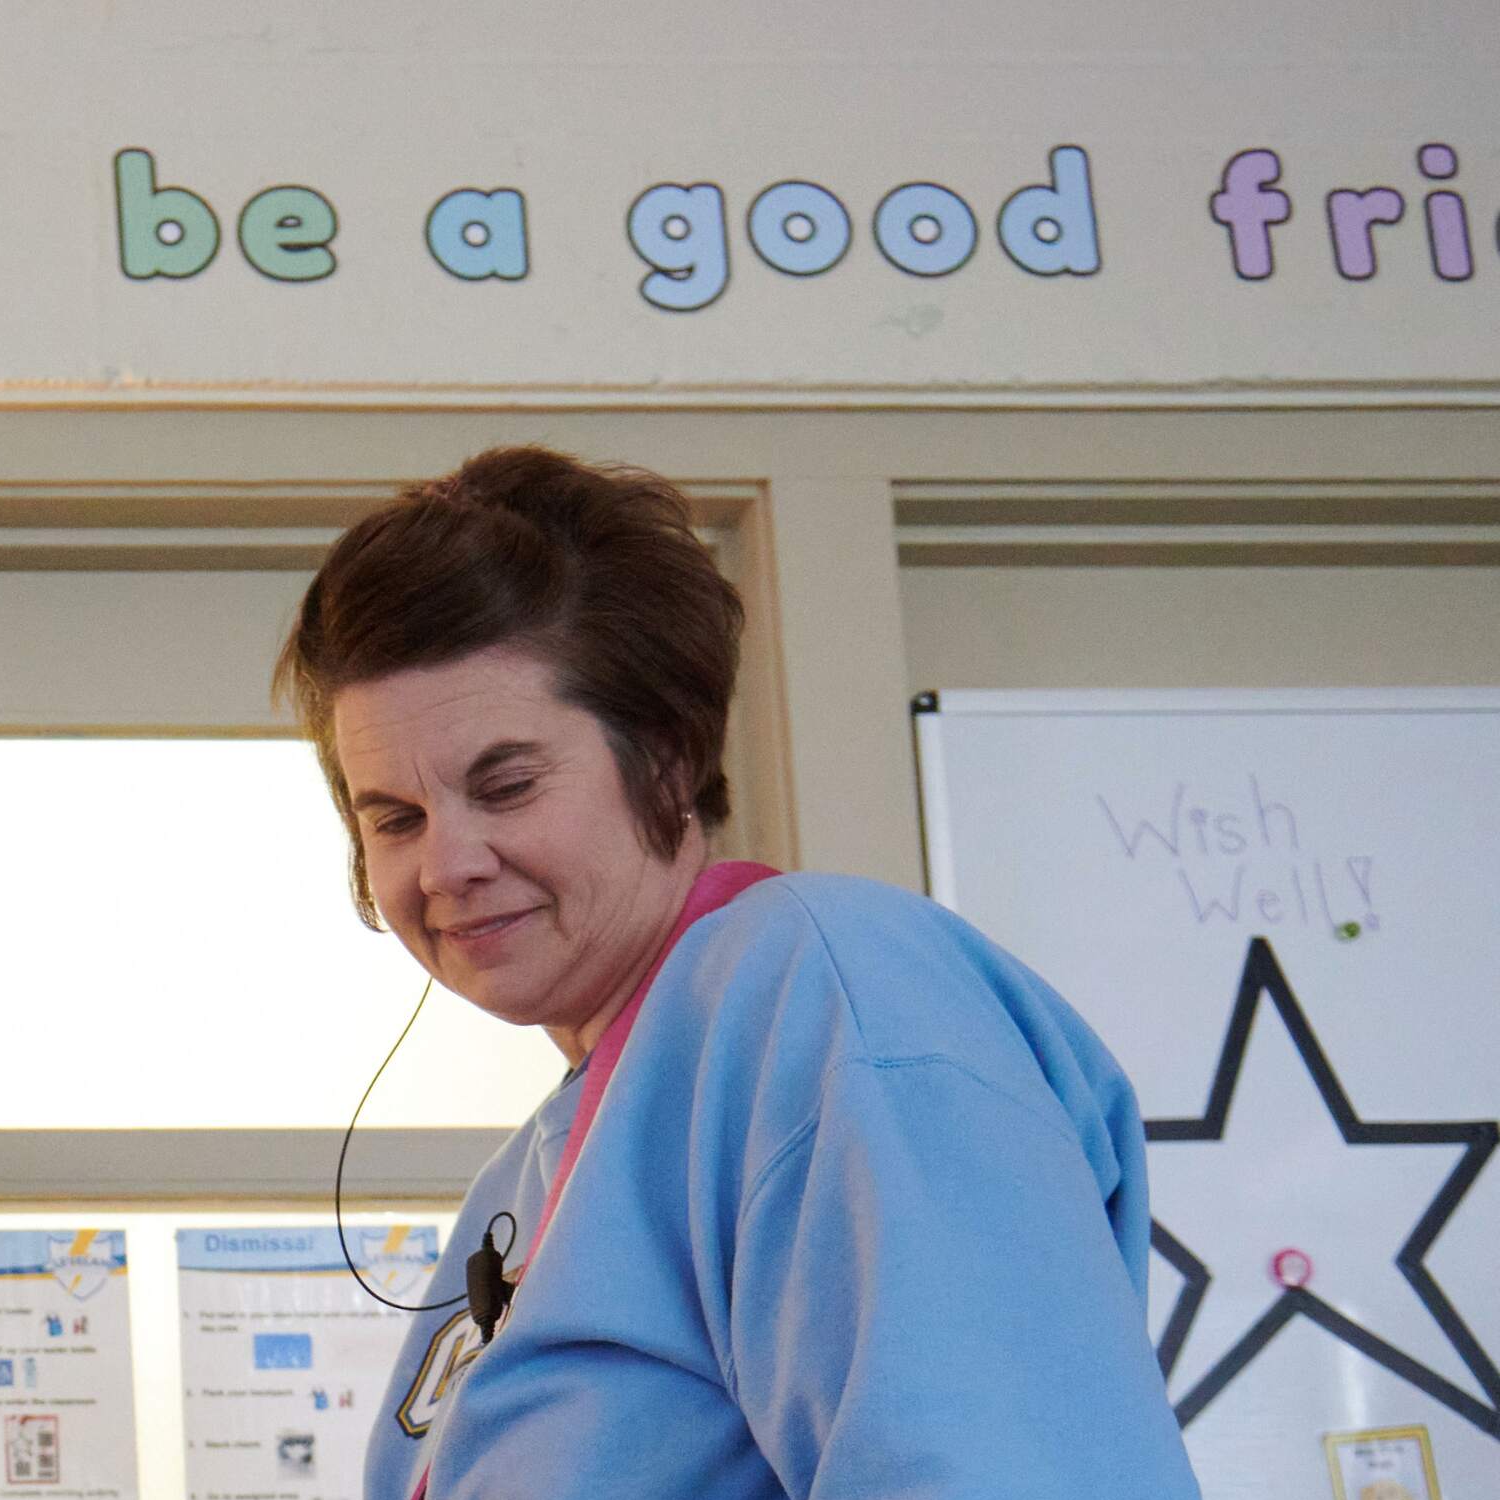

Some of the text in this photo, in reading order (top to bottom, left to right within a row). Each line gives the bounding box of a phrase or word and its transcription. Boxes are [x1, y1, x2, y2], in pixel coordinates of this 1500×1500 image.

[114, 148, 338, 281] be
[426, 188, 530, 281] a
[626, 144, 1102, 312] good
[1209, 143, 1500, 281] fri
[1097, 772, 1299, 859] Wish
[204, 1233, 314, 1252] Dismissal
